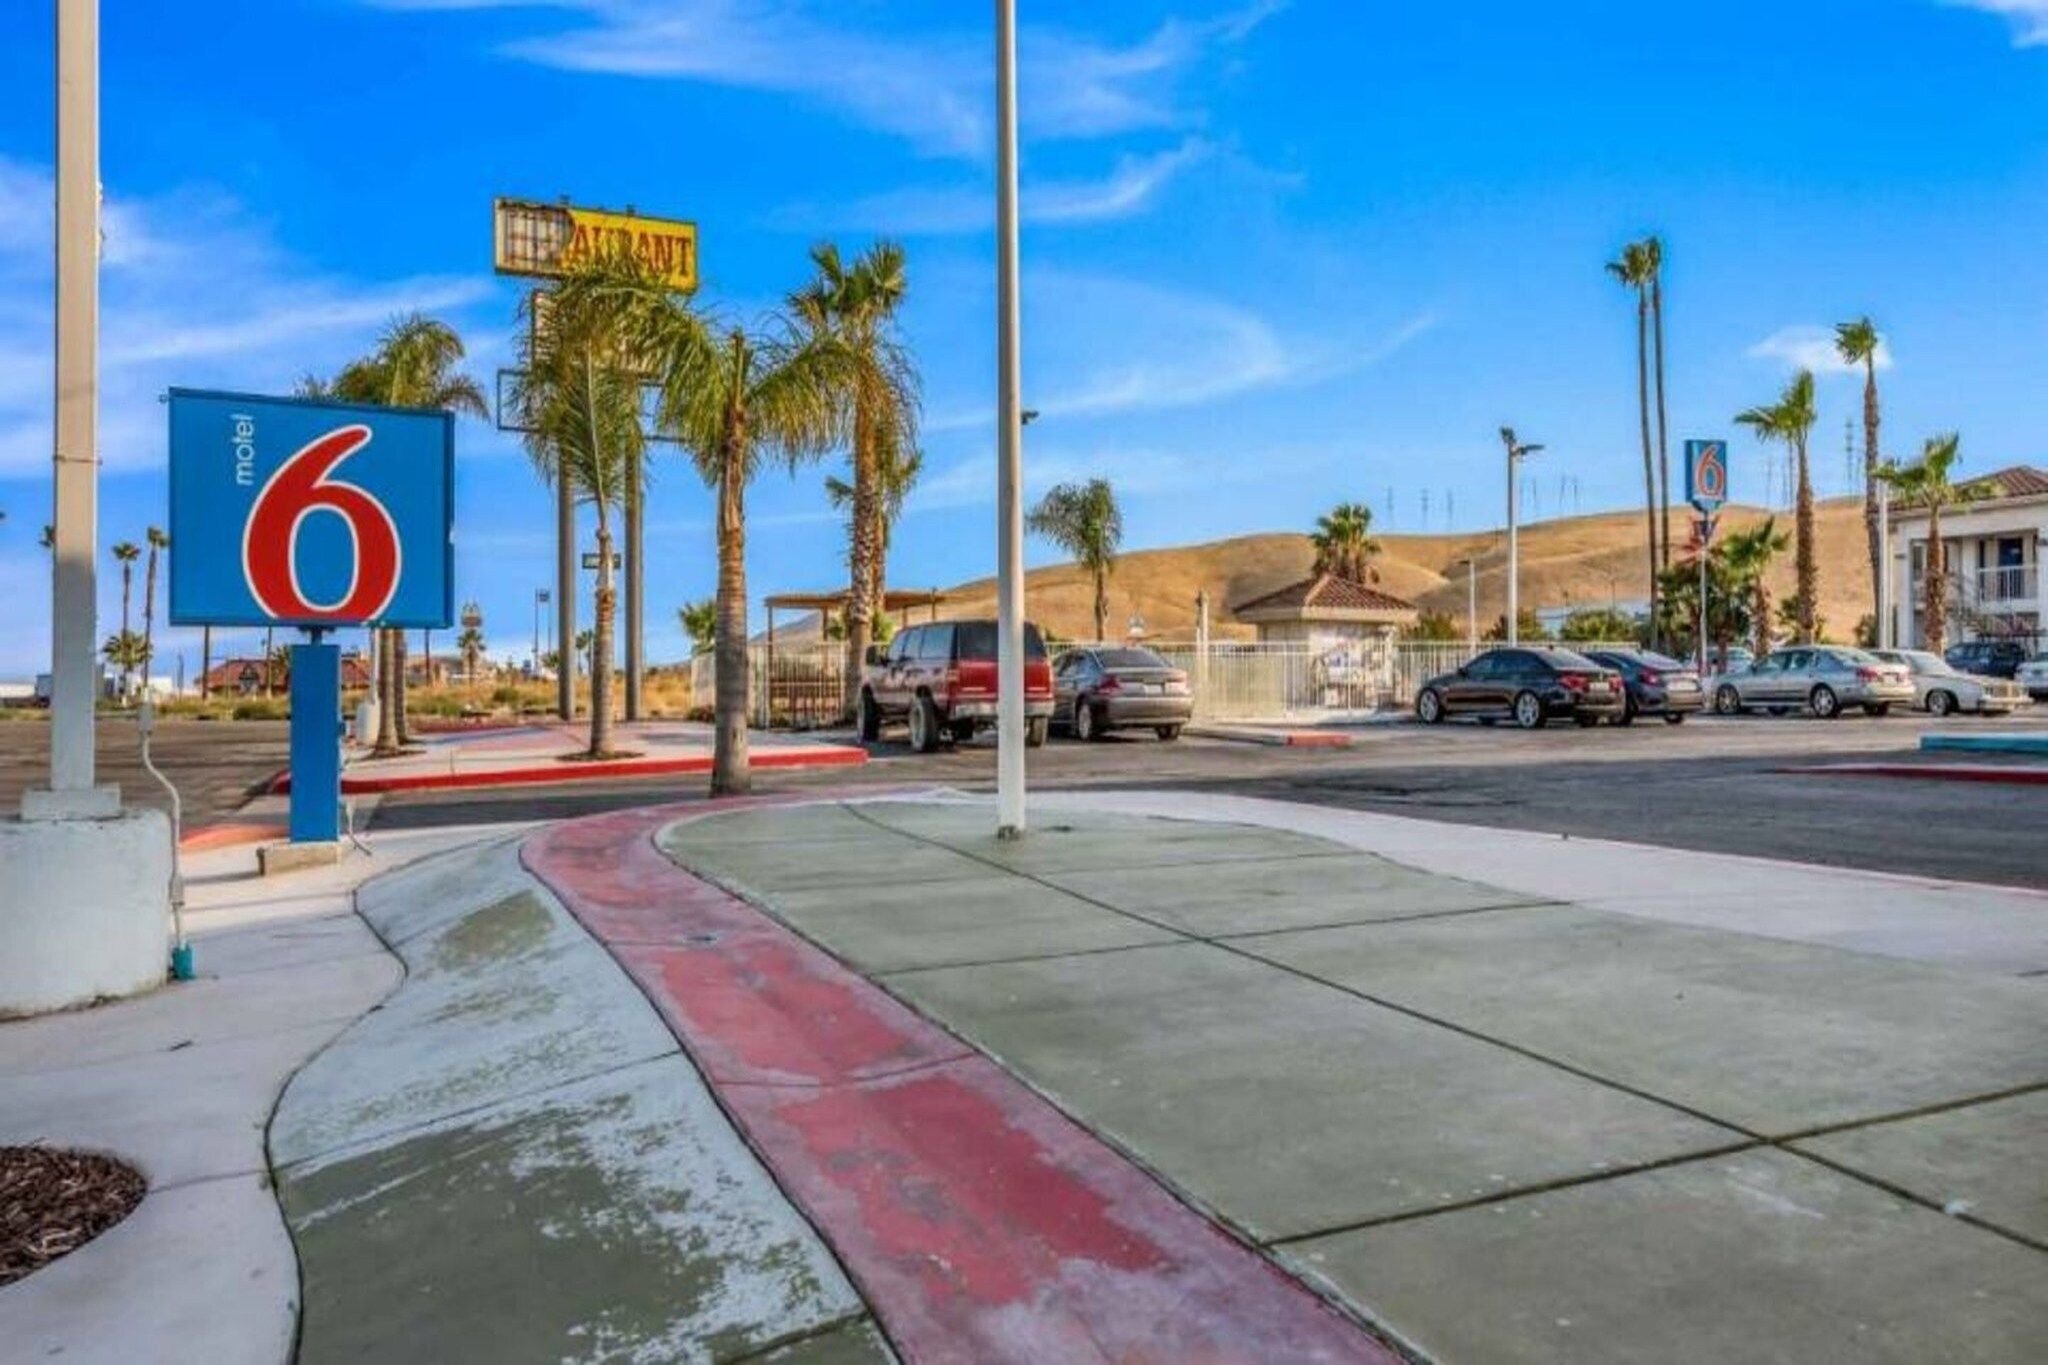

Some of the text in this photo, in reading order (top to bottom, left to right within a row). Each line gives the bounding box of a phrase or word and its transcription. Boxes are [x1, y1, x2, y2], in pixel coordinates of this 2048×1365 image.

[230, 413, 255, 486] motel
[1695, 445, 1725, 496] 6
[242, 424, 401, 621] 6
